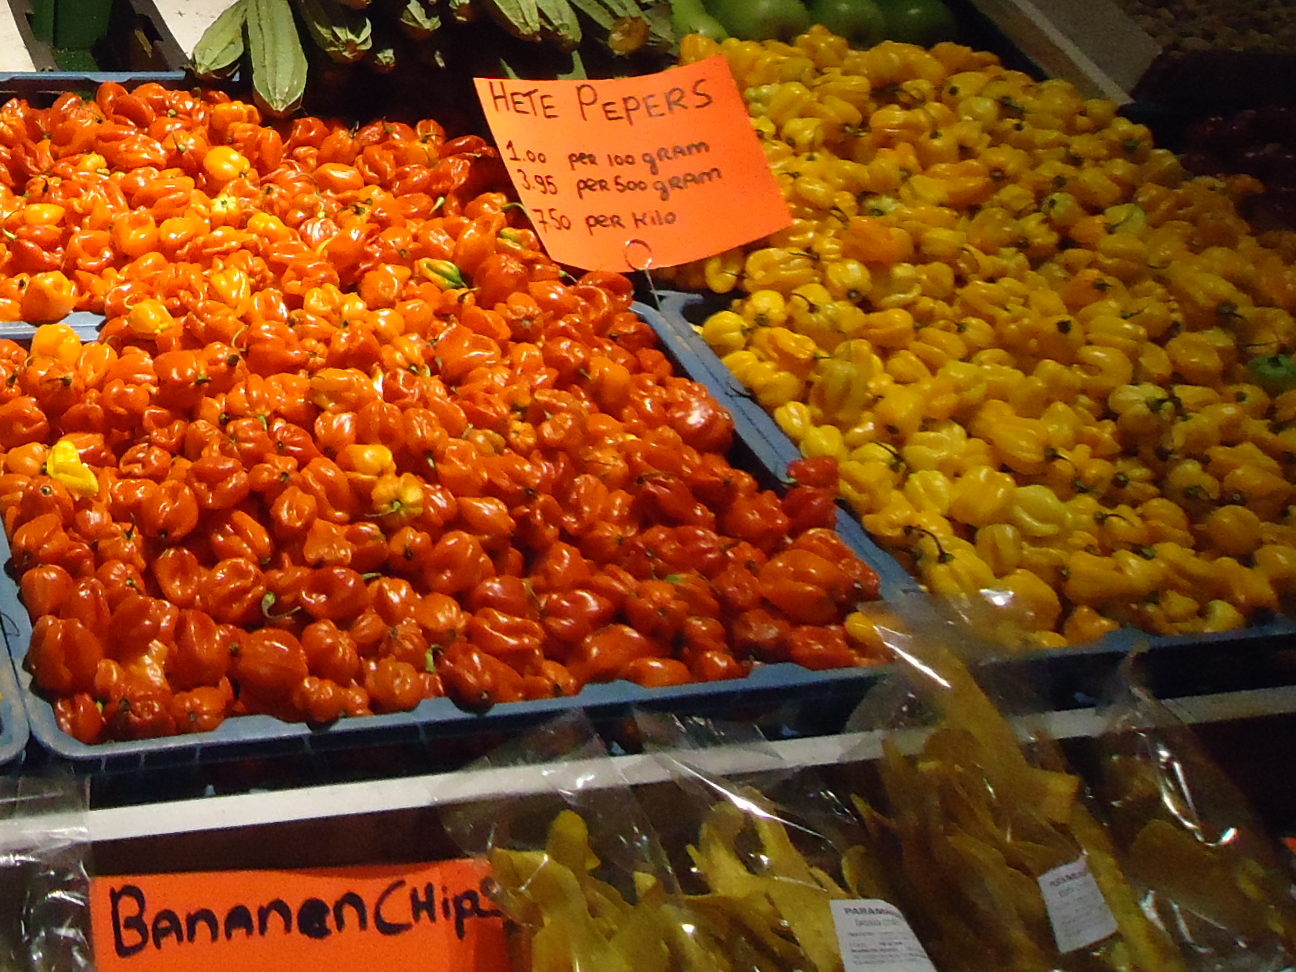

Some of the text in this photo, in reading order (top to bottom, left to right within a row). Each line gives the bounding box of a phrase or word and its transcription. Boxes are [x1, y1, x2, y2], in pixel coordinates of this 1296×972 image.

[489, 78, 714, 127] HETE PEPERS
[505, 140, 548, 164] 1.00
[519, 168, 559, 196] 3.95
